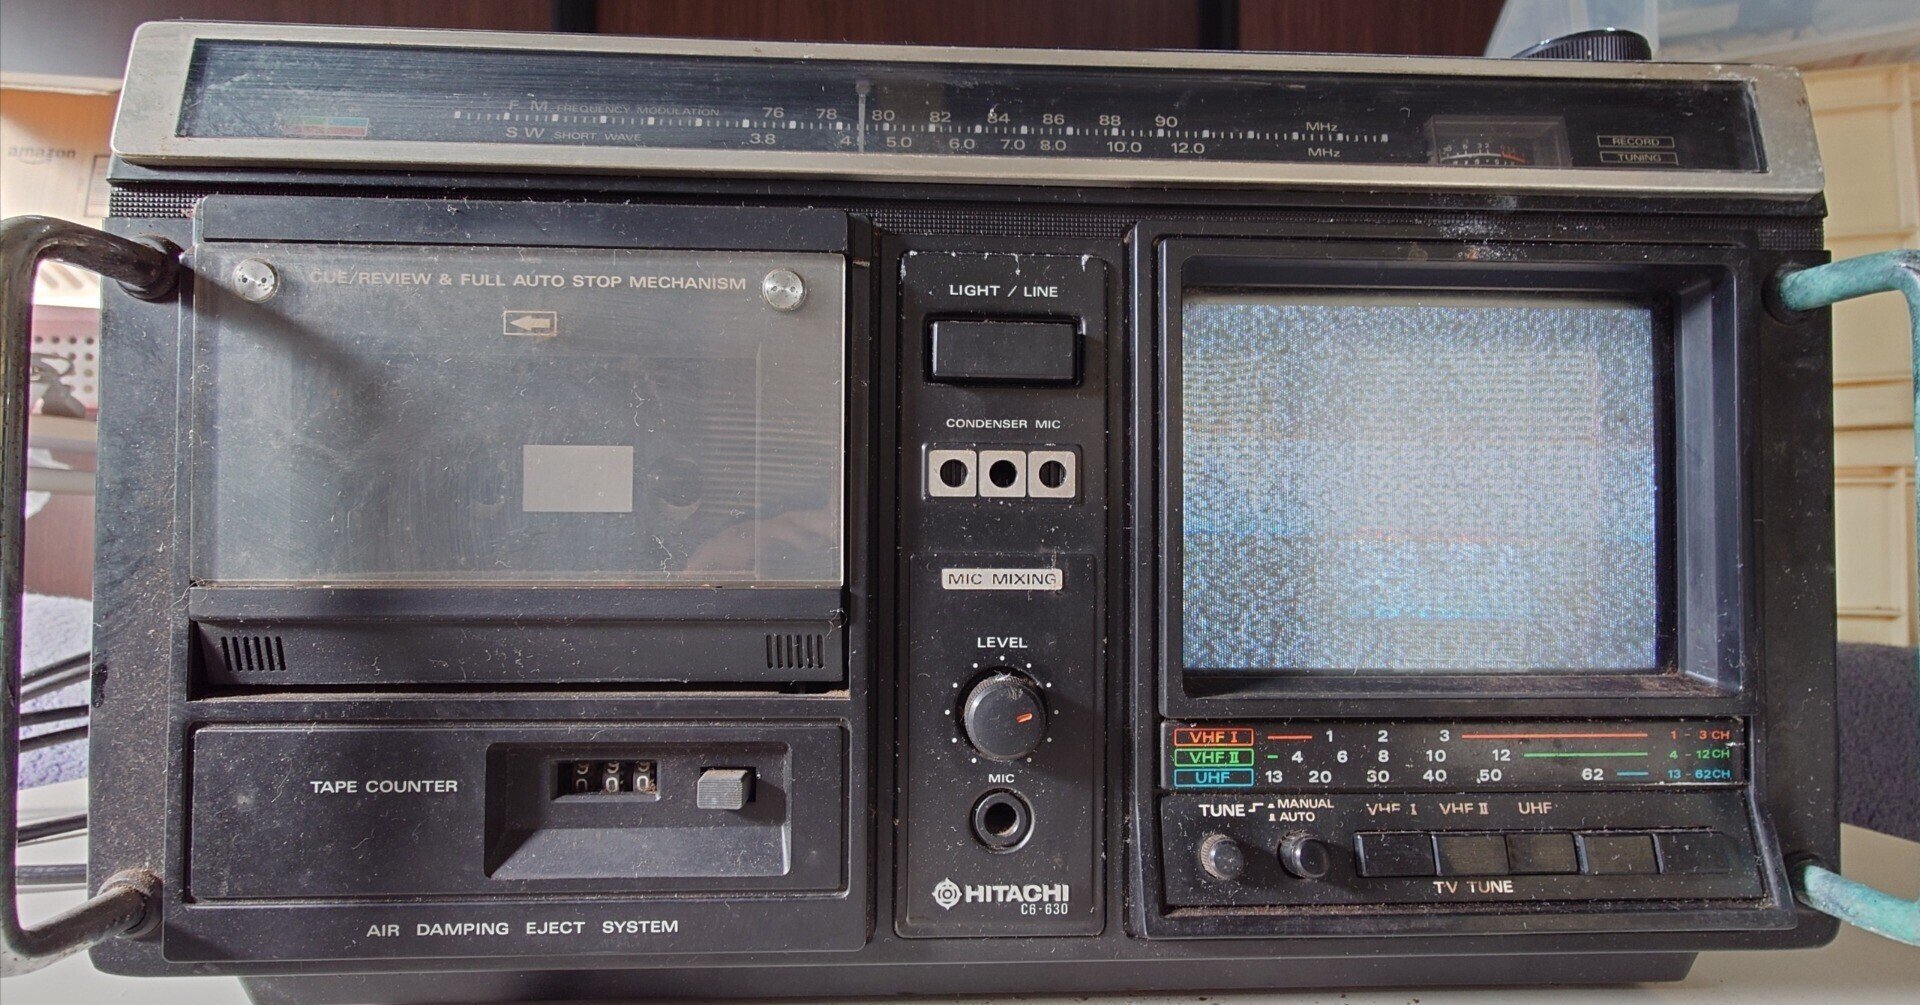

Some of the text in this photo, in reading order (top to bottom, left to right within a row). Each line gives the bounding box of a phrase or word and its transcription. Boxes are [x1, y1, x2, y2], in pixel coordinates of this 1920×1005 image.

[557, 104, 631, 115] FREQUENCY
[637, 107, 720, 117] MODULATION
[763, 107, 1339, 132] 76 78 80 82 84 86 88 90 MHz
[553, 131, 597, 141] SHORT
[604, 132, 642, 142] WAVE
[1612, 137, 1660, 146] RECORD
[749, 132, 777, 145] 3.8
[886, 136, 912, 148] 5.0
[948, 138, 976, 150] 6.0
[1000, 138, 1026, 151] 7.0
[1040, 139, 1067, 152] 8.0
[1107, 141, 1143, 154] 10.0
[1171, 143, 1205, 155] 12.0
[1307, 147, 1341, 158] MHz
[1618, 153, 1662, 162] TUNING
[309, 271, 747, 290] CUE/REVIEW & FULL AUTO STOP MECHANISM
[949, 284, 1000, 297] LIGHT
[1023, 286, 1058, 298] LINE
[946, 418, 1061, 430] CONDENSER MIC
[948, 573, 1057, 586] MIC MIXING
[977, 637, 1028, 649] LEVEL
[1190, 731, 1225, 744] VHF
[1325, 730, 1450, 743] 1 2 3
[1671, 730, 1677, 739] 1
[1189, 751, 1225, 764] VHF
[1291, 750, 1511, 763] 4 6 8 10 12
[1669, 750, 1678, 759] 4
[988, 774, 1015, 784] MIC
[1195, 771, 1230, 783] UHF
[1265, 769, 1604, 783] 13 20 30 40 50 62
[1668, 769, 1682, 779] 13
[310, 780, 458, 793] TAPE COUNTER
[1198, 804, 1246, 817] TUNE
[1277, 799, 1335, 809] MANUAL
[1368, 803, 1401, 815] VHF
[1440, 803, 1473, 815] VHF
[1517, 802, 1553, 815] UHF
[1279, 811, 1315, 822] AUTO
[965, 885, 1069, 903] HITACHI
[1433, 881, 1514, 894] TV TUNE
[1020, 903, 1068, 916] C6-630
[366, 920, 679, 937] AIR DAMPING EJECT SYSTEM
